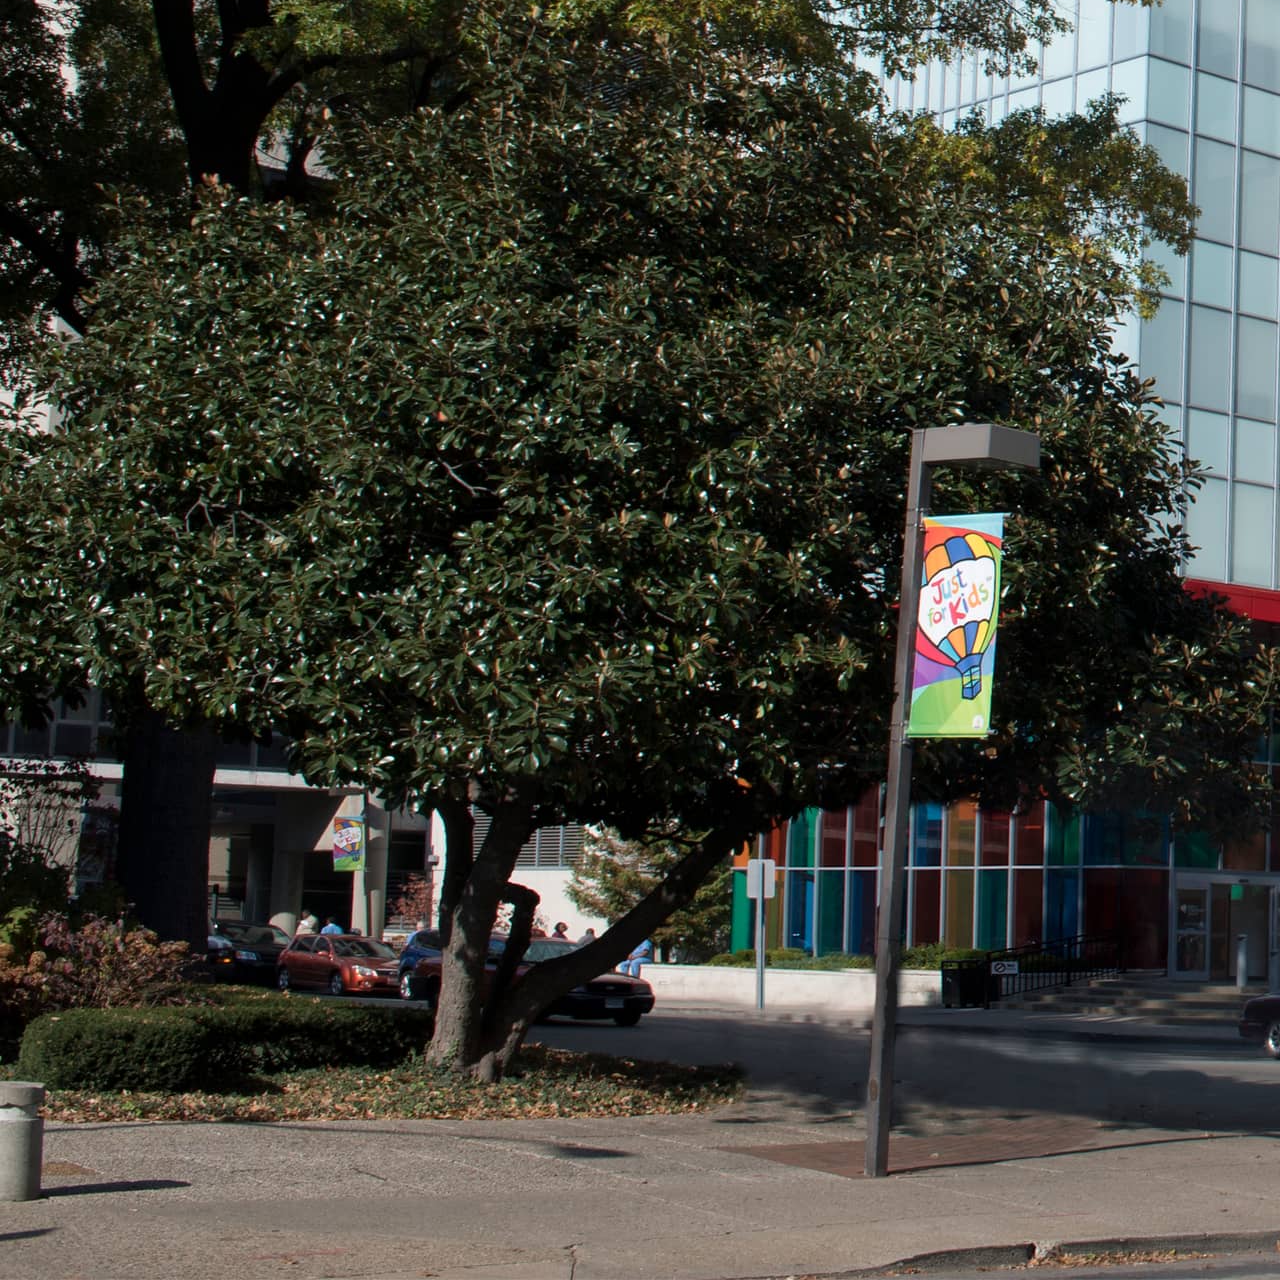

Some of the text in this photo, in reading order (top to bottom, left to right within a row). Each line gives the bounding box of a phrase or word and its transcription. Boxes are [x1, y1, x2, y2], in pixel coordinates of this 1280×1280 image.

[928, 582, 989, 627] for Kids
[931, 568, 967, 605] Just
